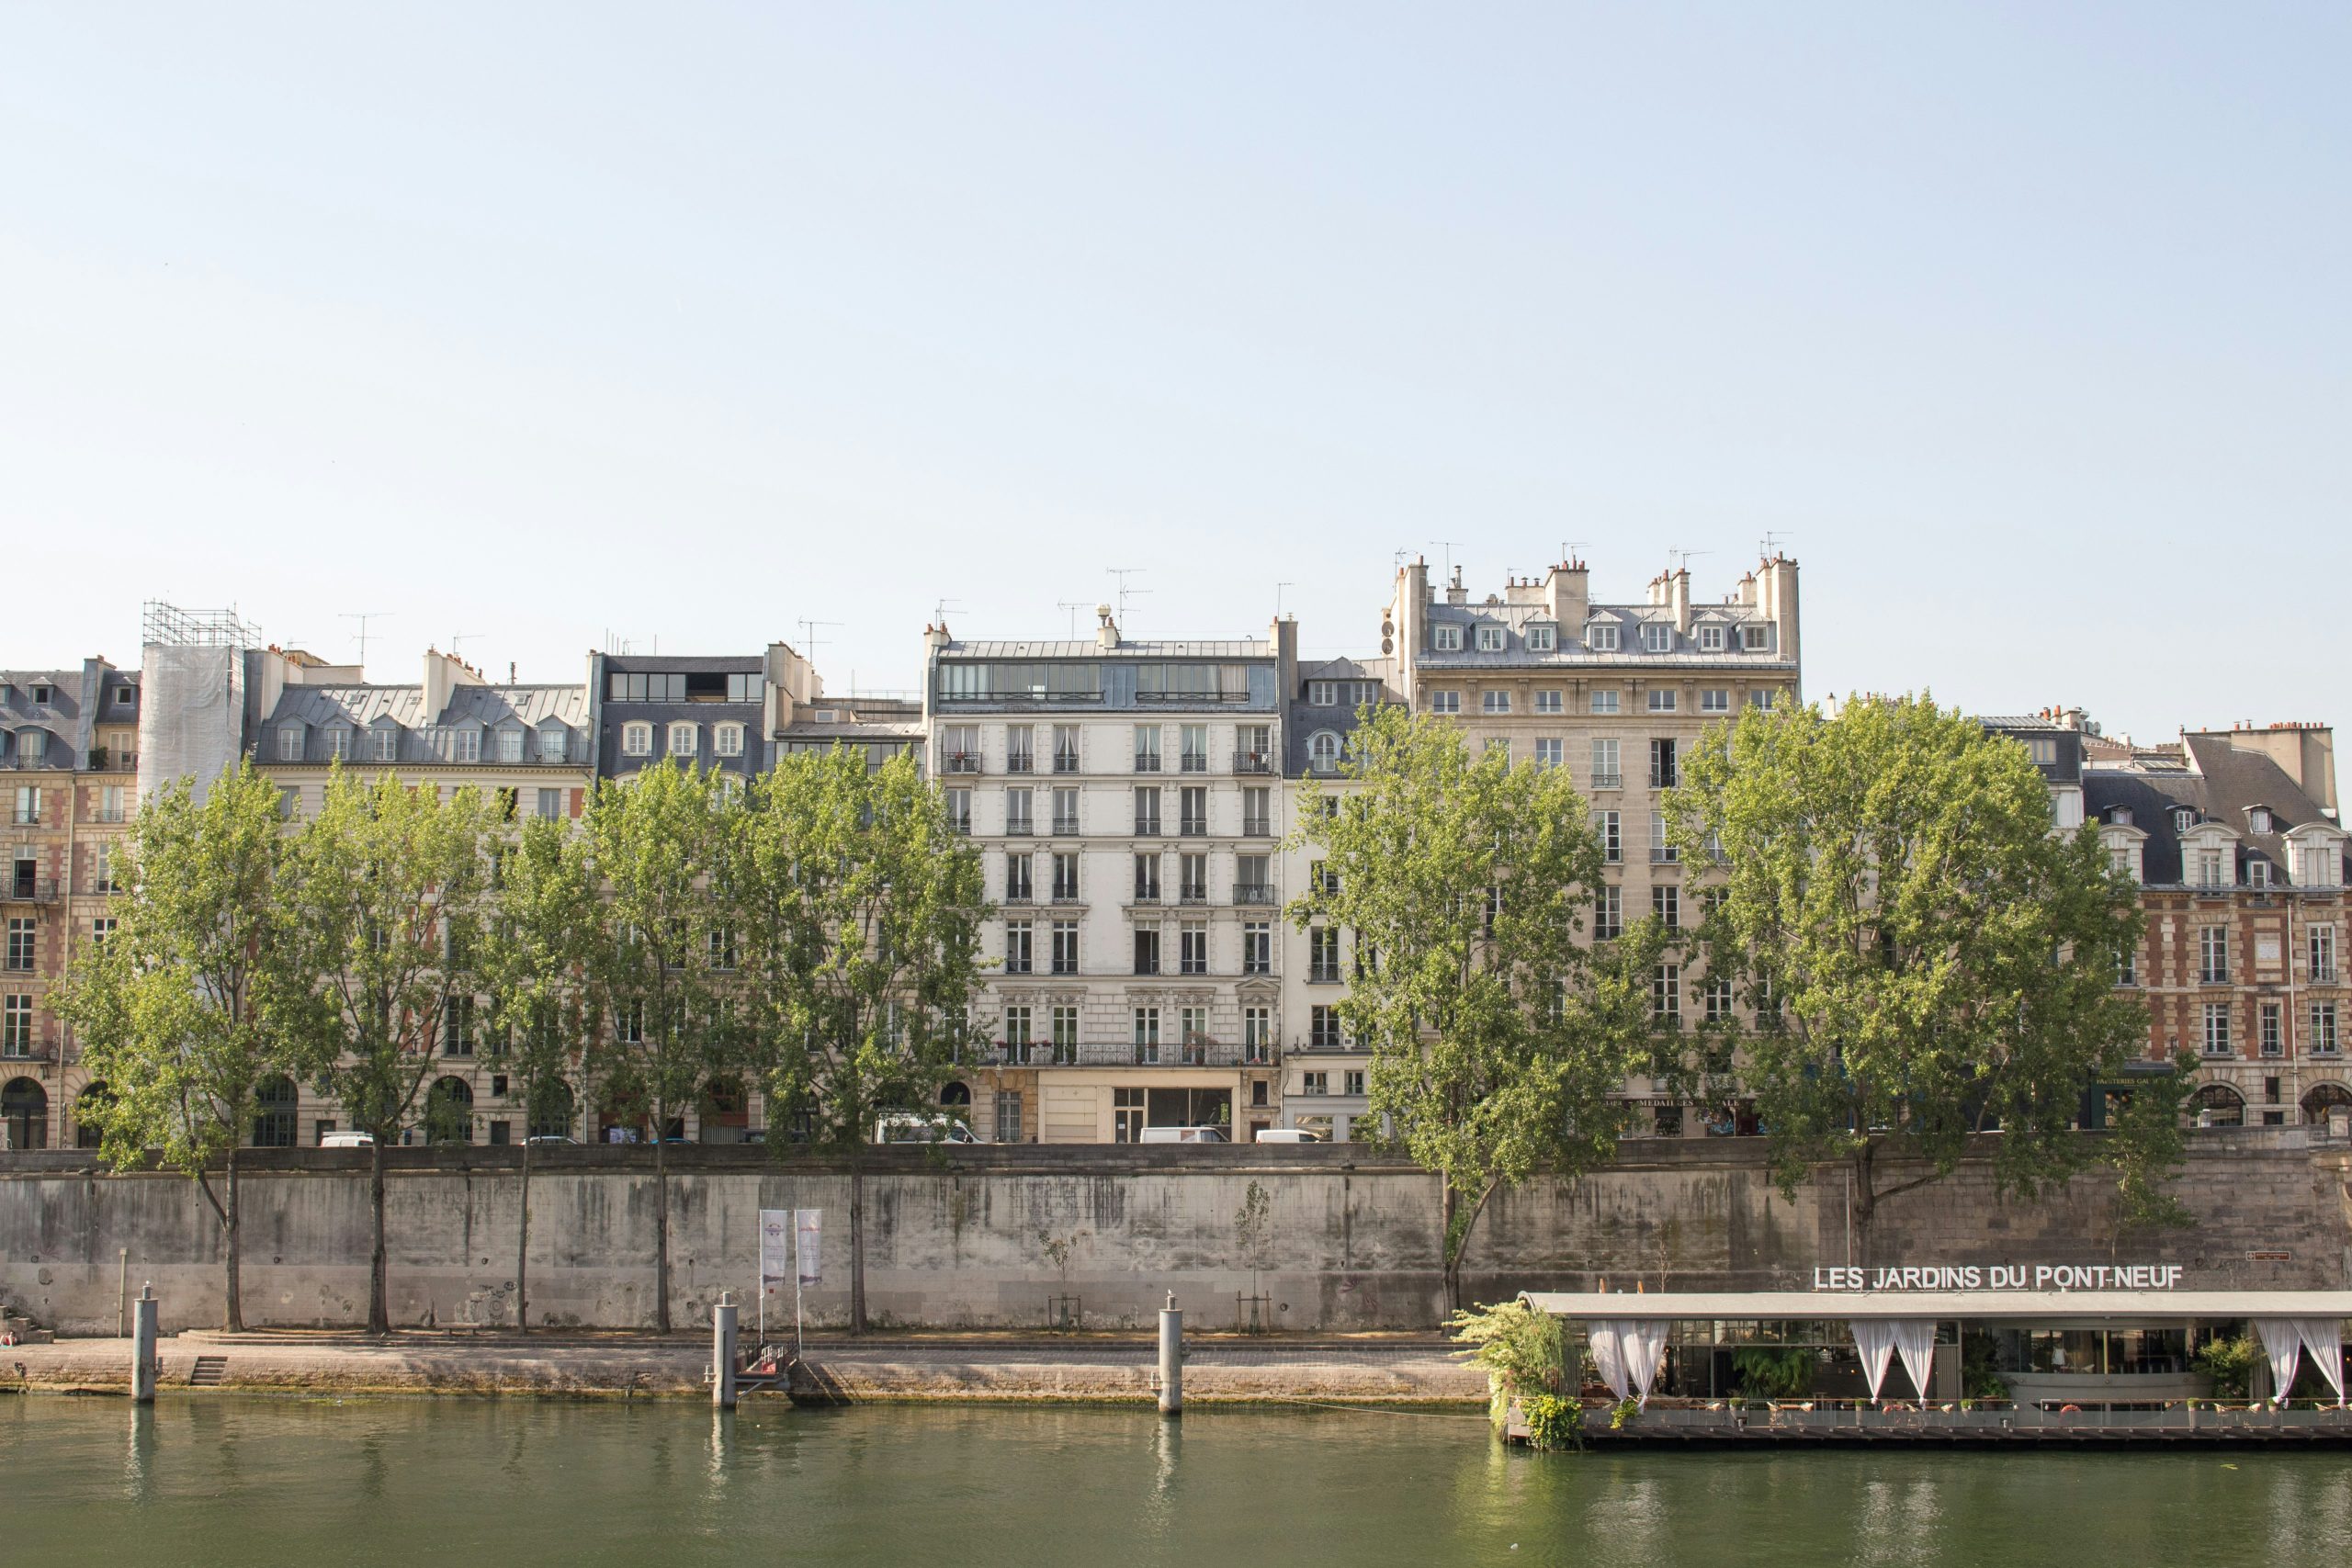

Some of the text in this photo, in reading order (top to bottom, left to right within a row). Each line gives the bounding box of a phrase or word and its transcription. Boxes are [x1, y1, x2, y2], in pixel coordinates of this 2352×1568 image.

[1815, 1265, 2183, 1289] LES JARDINS DU PONT-NEUF
